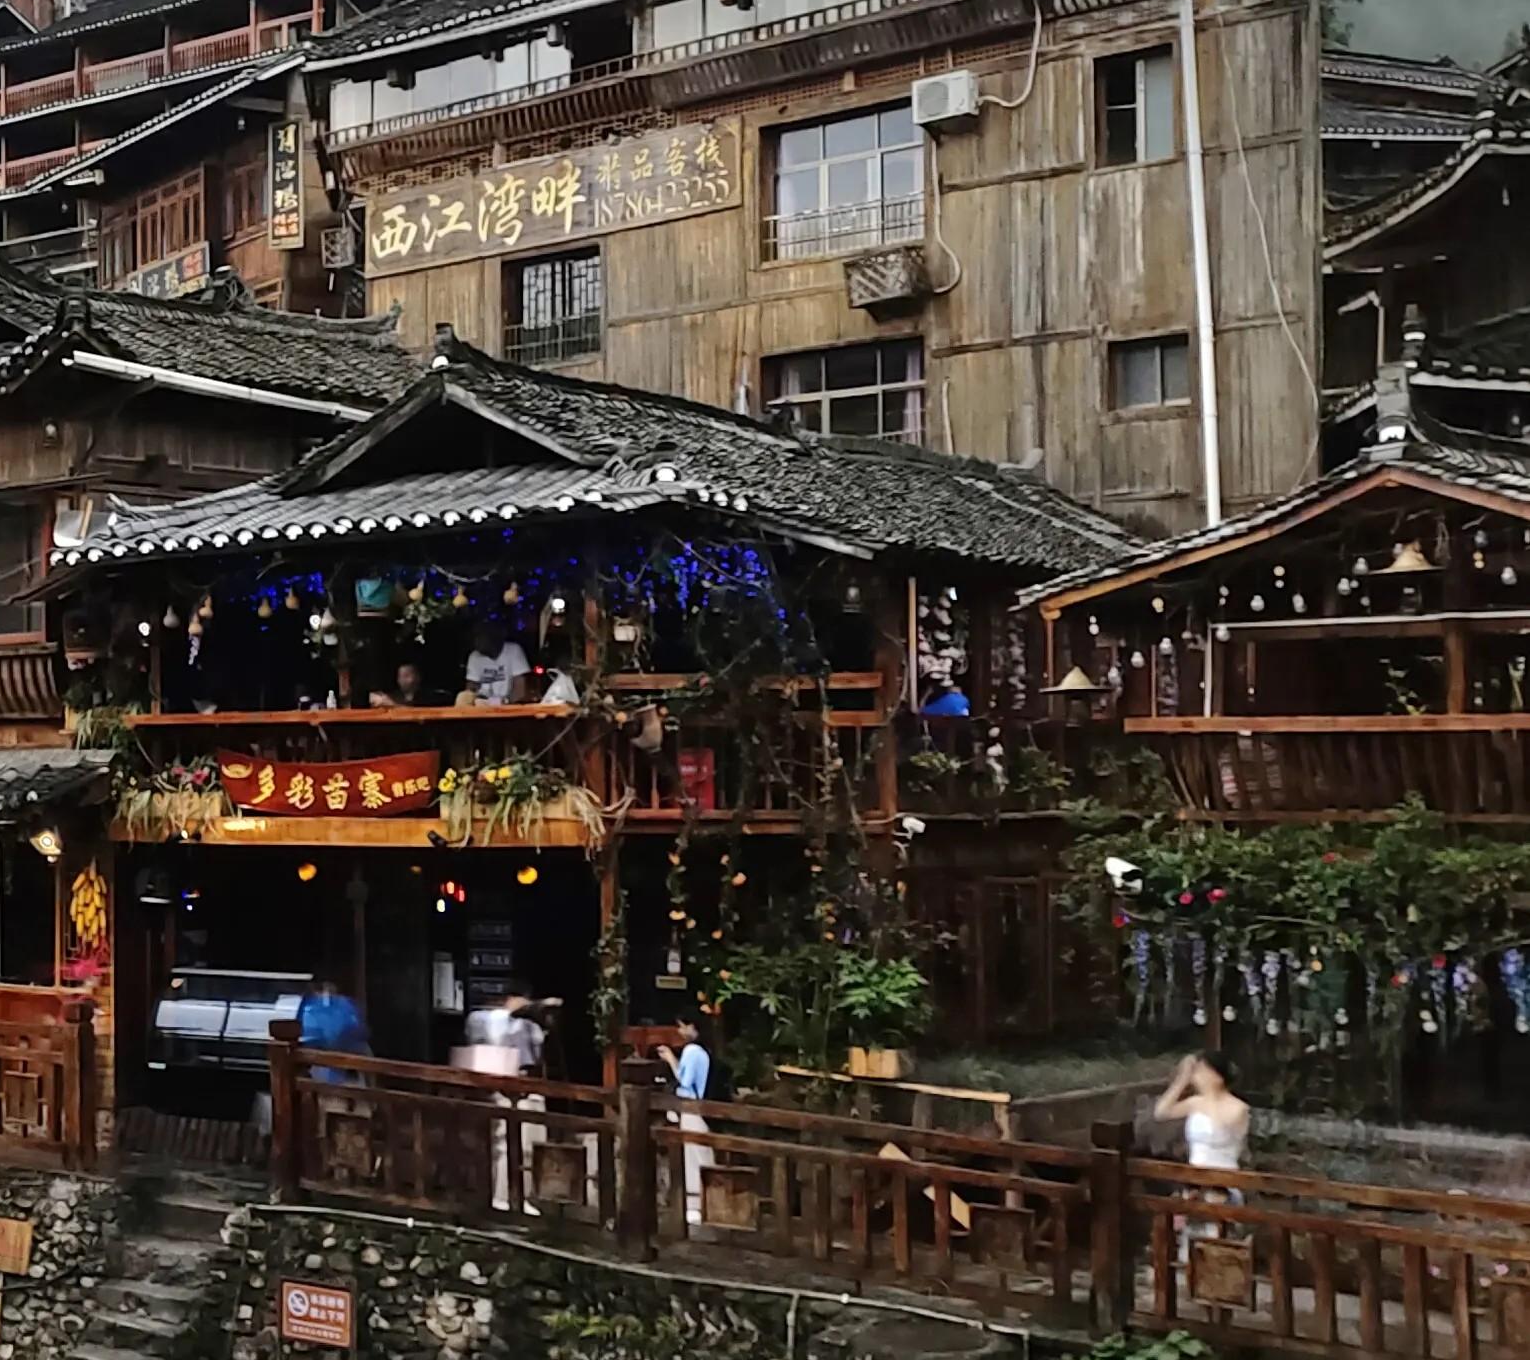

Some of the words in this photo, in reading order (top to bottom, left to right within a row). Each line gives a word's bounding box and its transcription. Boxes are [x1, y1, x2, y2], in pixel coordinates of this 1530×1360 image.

[595, 133, 726, 192] 精品客栈
[371, 157, 587, 260] 西江湾畔
[250, 763, 392, 811] 多彩苗寨
